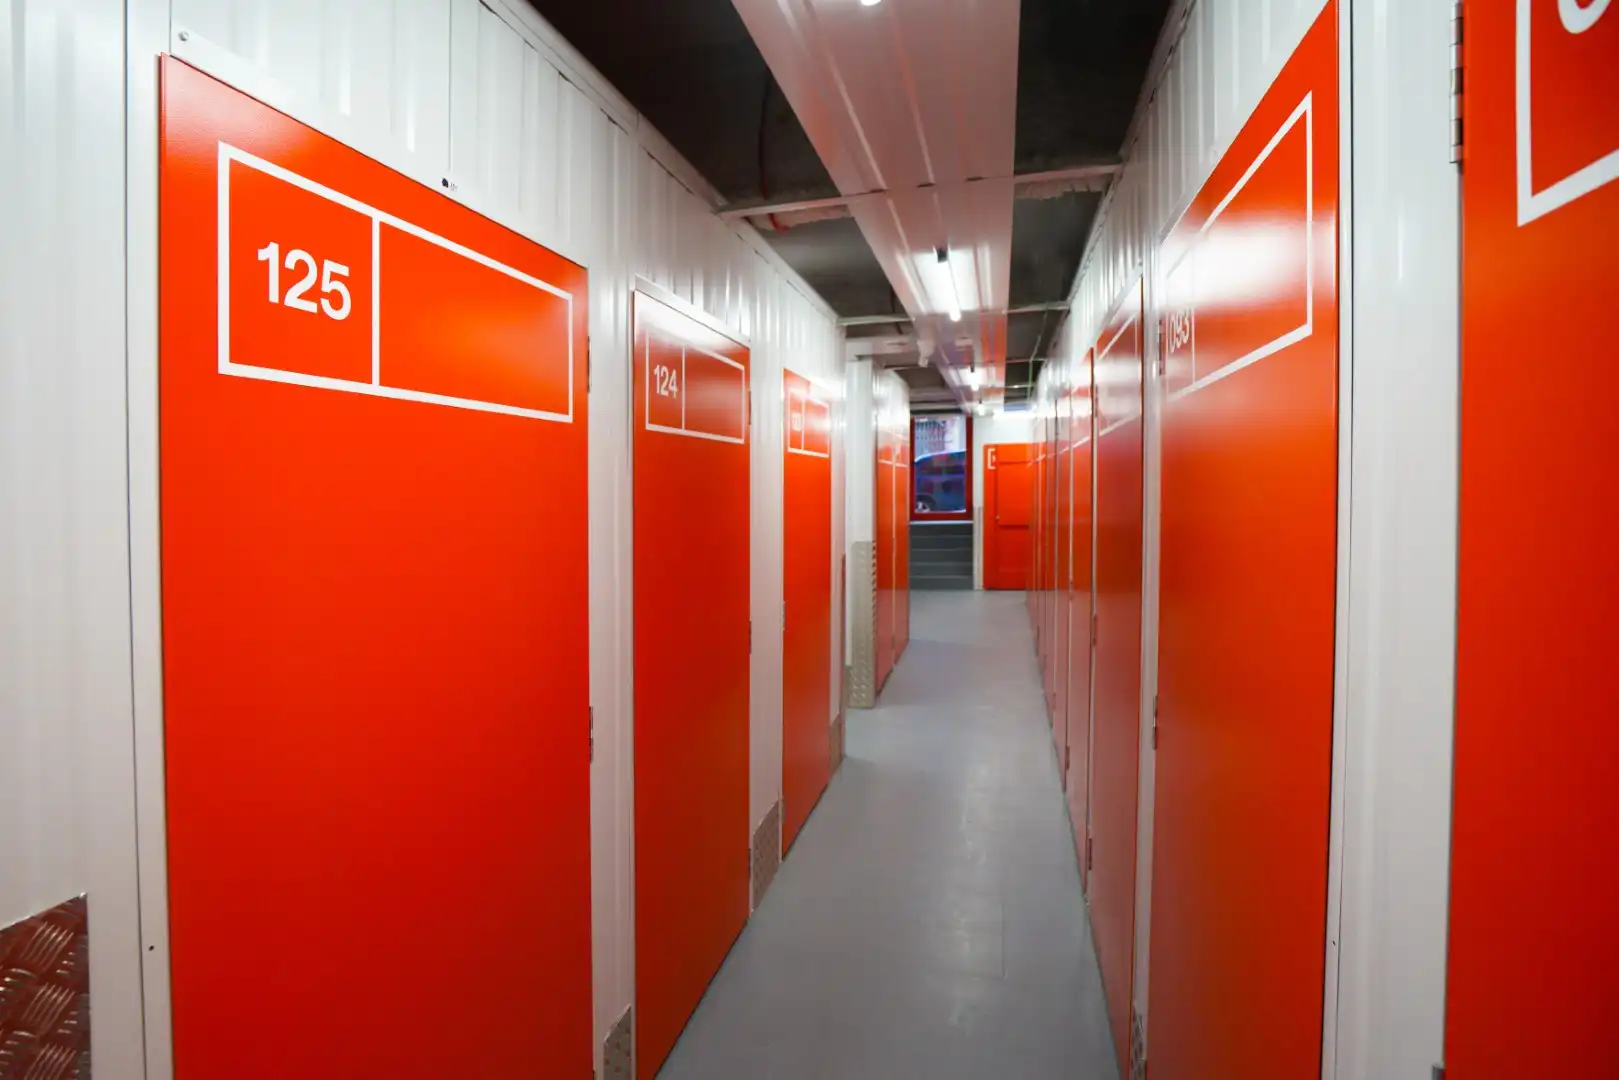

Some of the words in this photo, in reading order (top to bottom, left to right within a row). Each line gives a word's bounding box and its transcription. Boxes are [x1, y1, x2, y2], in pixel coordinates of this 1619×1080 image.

[257, 241, 352, 321] 125
[1169, 308, 1190, 354] 093
[653, 364, 678, 400] 124
